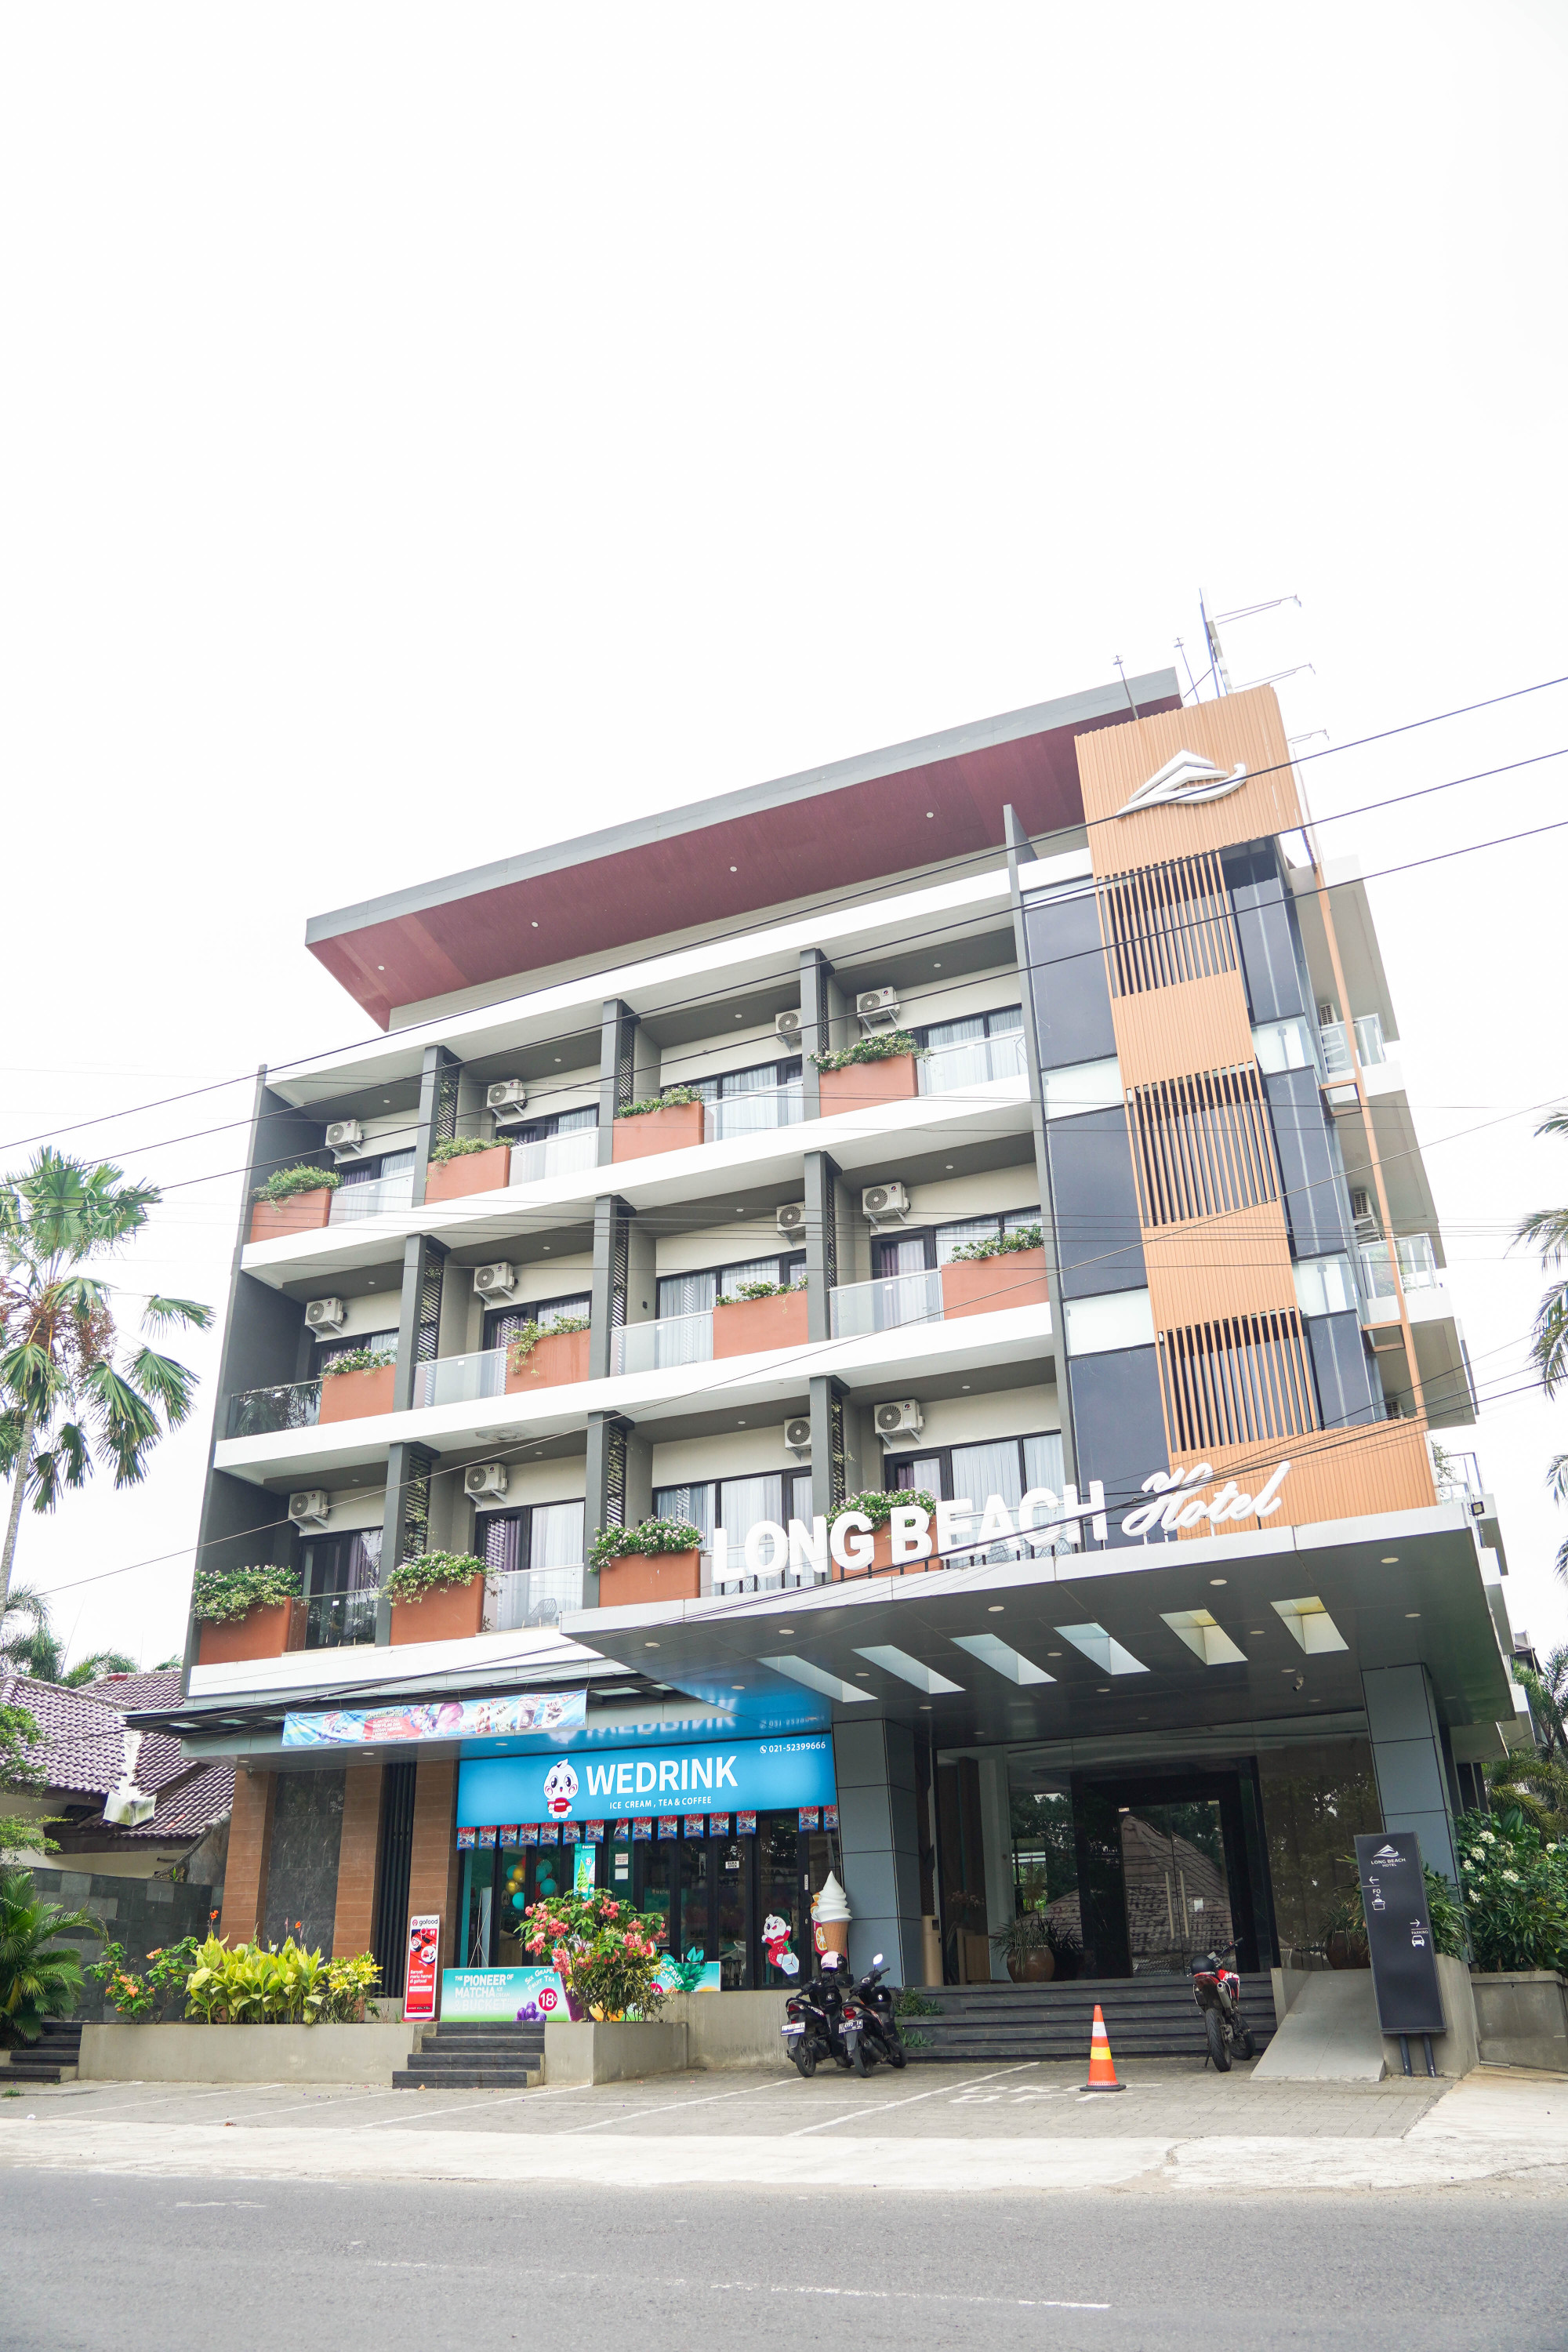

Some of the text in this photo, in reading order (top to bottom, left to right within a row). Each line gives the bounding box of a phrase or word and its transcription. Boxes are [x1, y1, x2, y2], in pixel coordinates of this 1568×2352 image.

[712, 1461, 1291, 1584] LONG BEACH Hotel
[768, 1741, 826, 1753] 021-52399666
[586, 1756, 739, 1795] WEDRINK
[658, 1798, 673, 1806] TEA
[682, 1796, 712, 1806] COFFEE
[463, 1974, 506, 1986] PIONEER
[661, 1971, 676, 1985] CKET
[669, 1964, 684, 1985] FRUIT
[455, 1987, 496, 1998] MATCHA
[948, 2093, 1133, 2103] OFF
